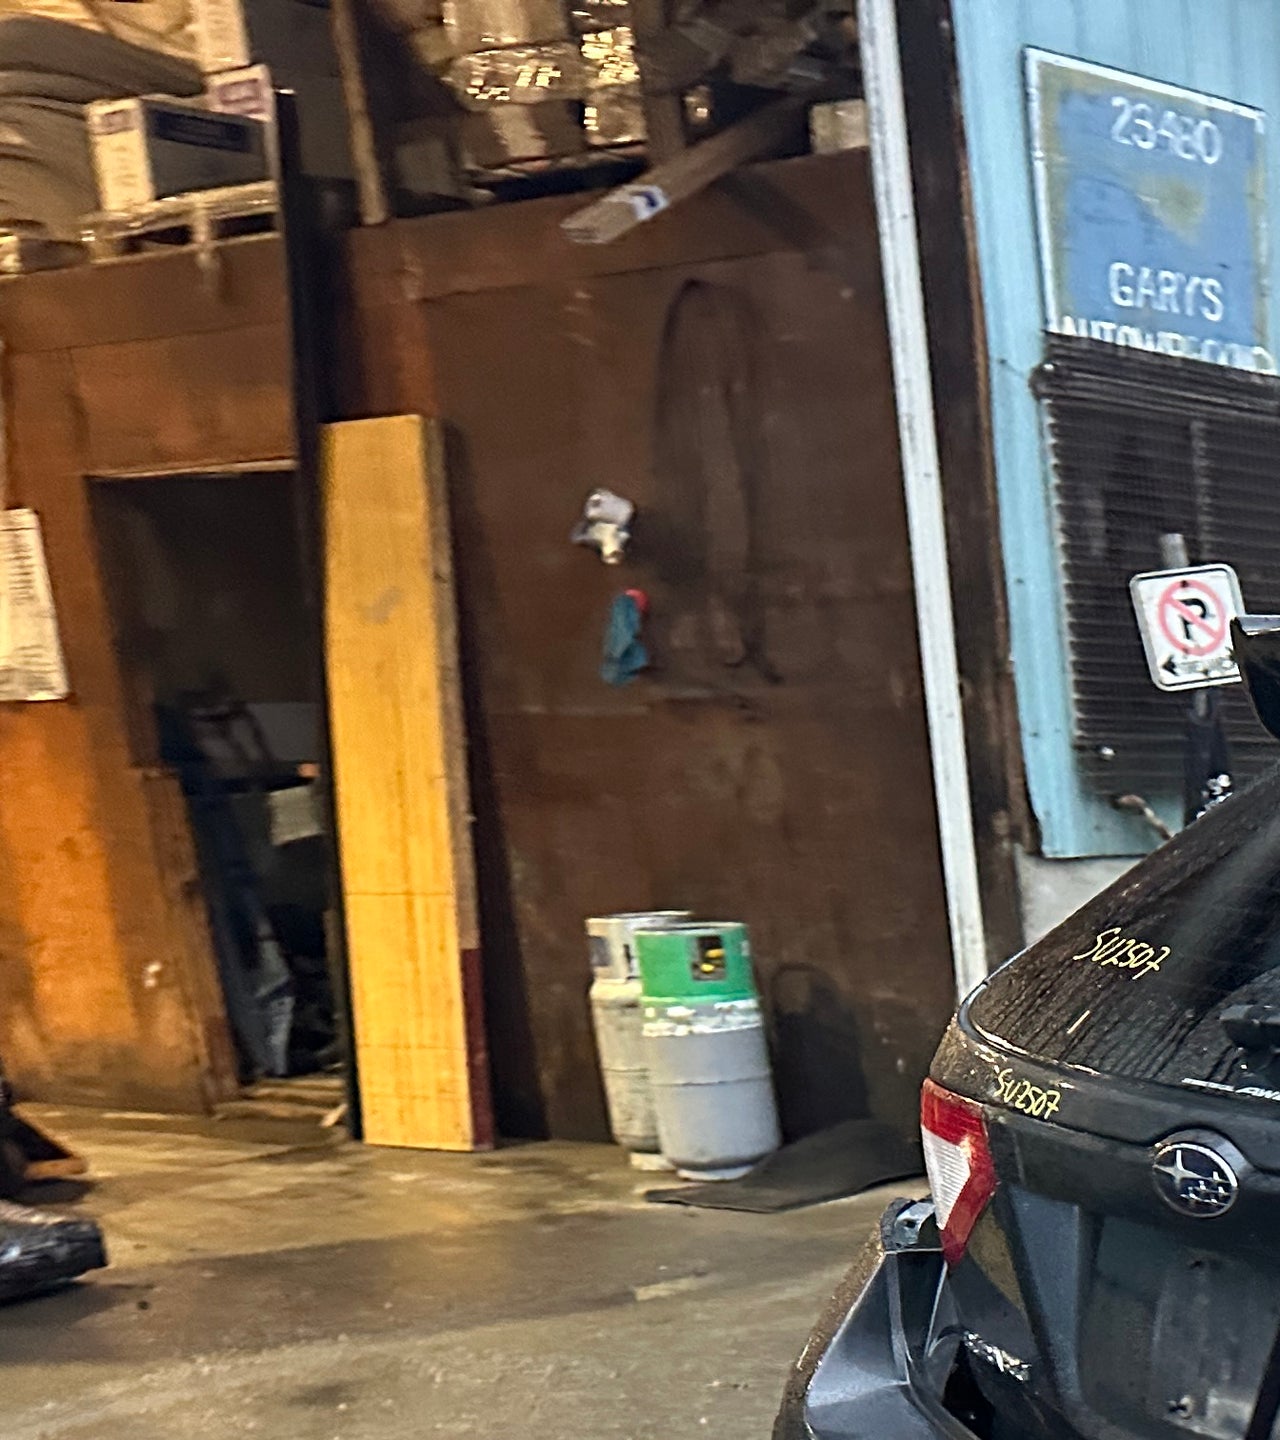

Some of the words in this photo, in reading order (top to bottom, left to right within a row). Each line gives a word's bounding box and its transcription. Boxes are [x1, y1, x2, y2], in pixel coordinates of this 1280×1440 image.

[1109, 262, 1225, 322] GARYS
[1073, 927, 1170, 980] SU2507
[994, 1068, 1061, 1119] SU2507
